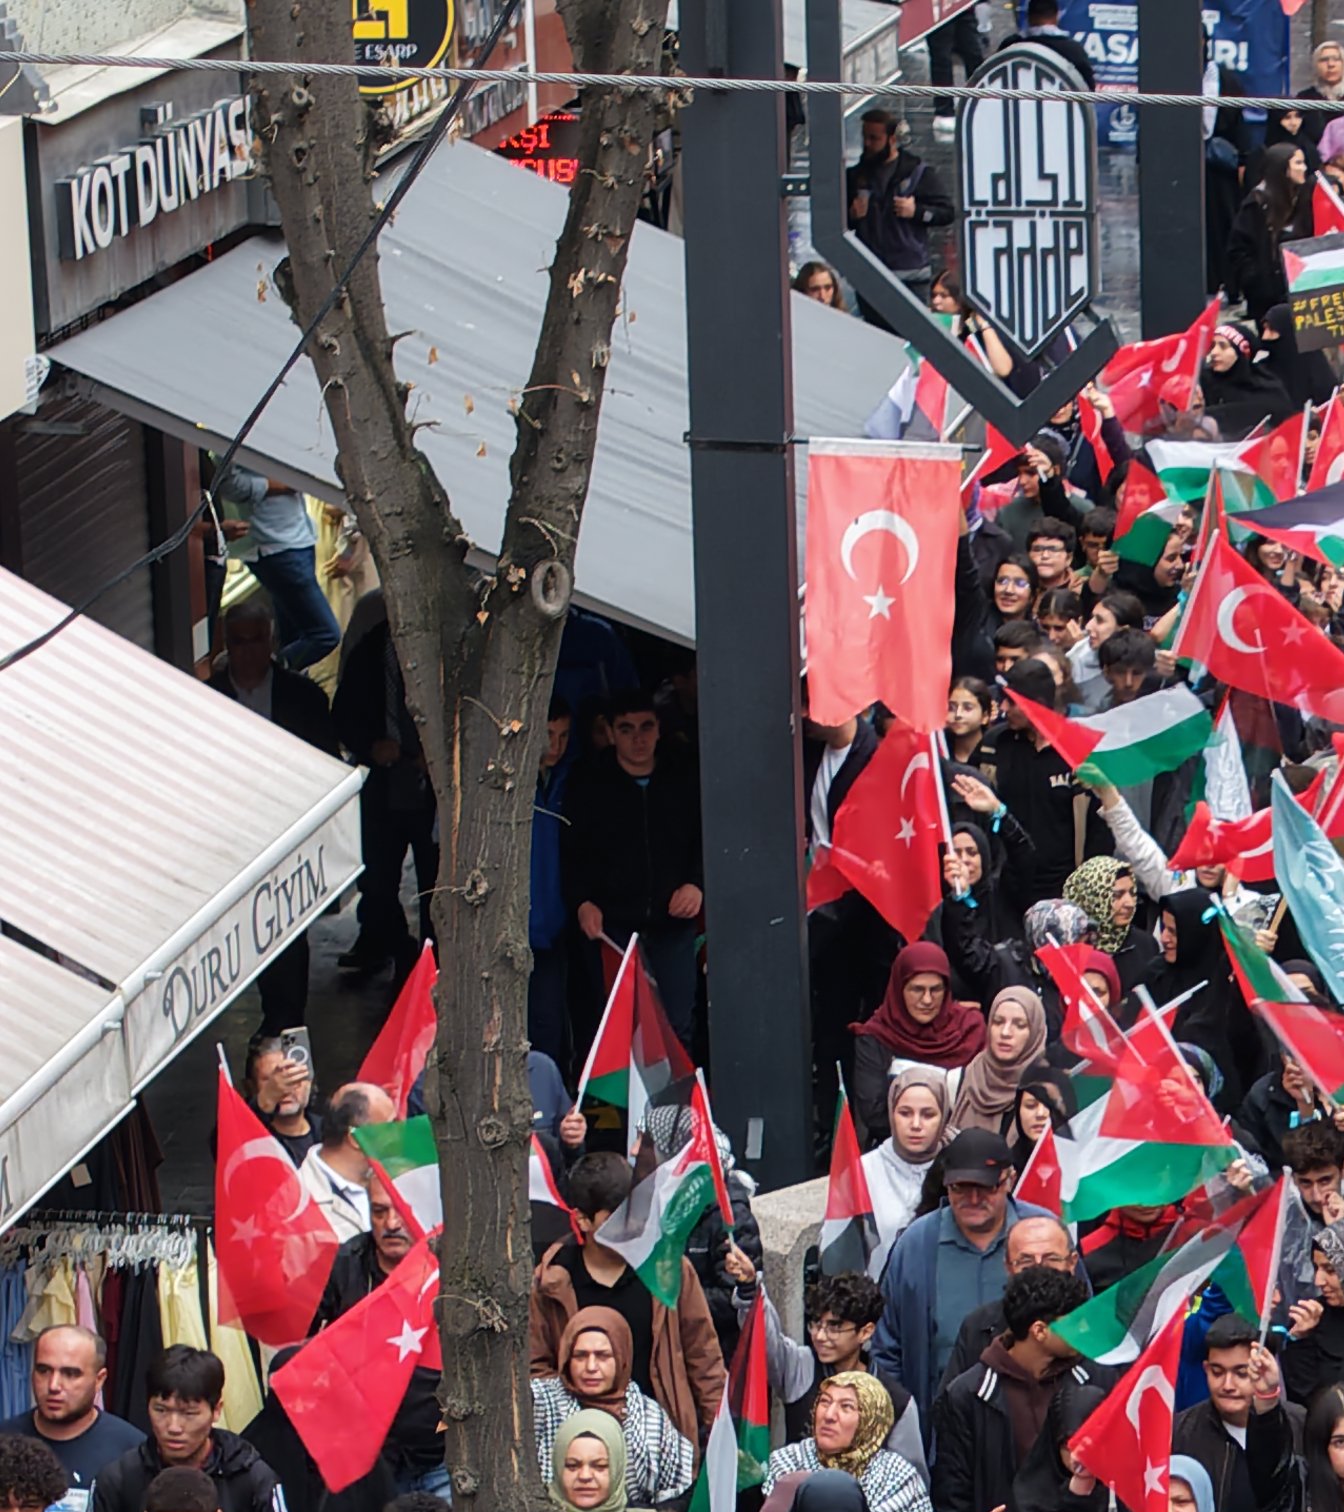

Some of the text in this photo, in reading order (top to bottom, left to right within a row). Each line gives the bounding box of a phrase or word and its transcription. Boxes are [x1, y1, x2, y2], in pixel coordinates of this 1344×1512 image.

[71, 154, 131, 261] KOT
[163, 844, 328, 1044] DURU GİYİM
